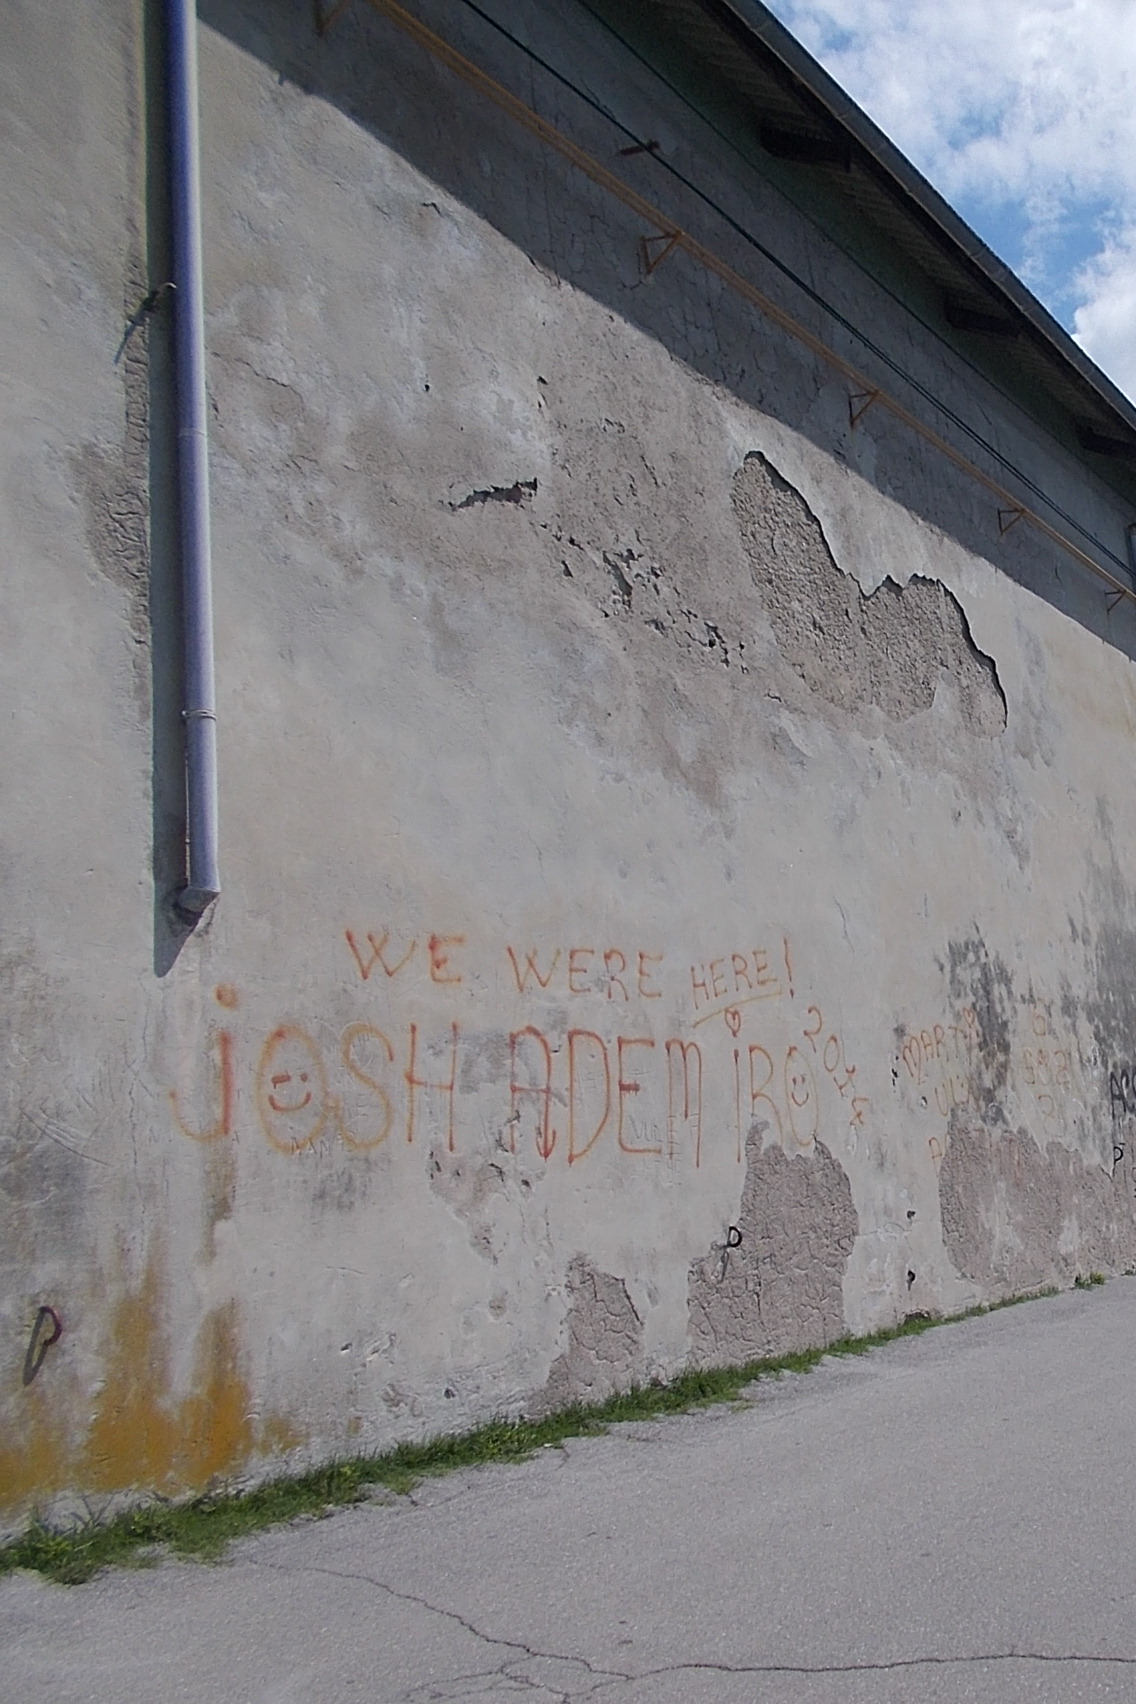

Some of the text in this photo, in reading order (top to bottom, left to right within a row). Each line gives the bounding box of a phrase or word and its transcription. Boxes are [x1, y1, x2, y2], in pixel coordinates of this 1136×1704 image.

[345, 929, 796, 1010] WE WERE HERE!
